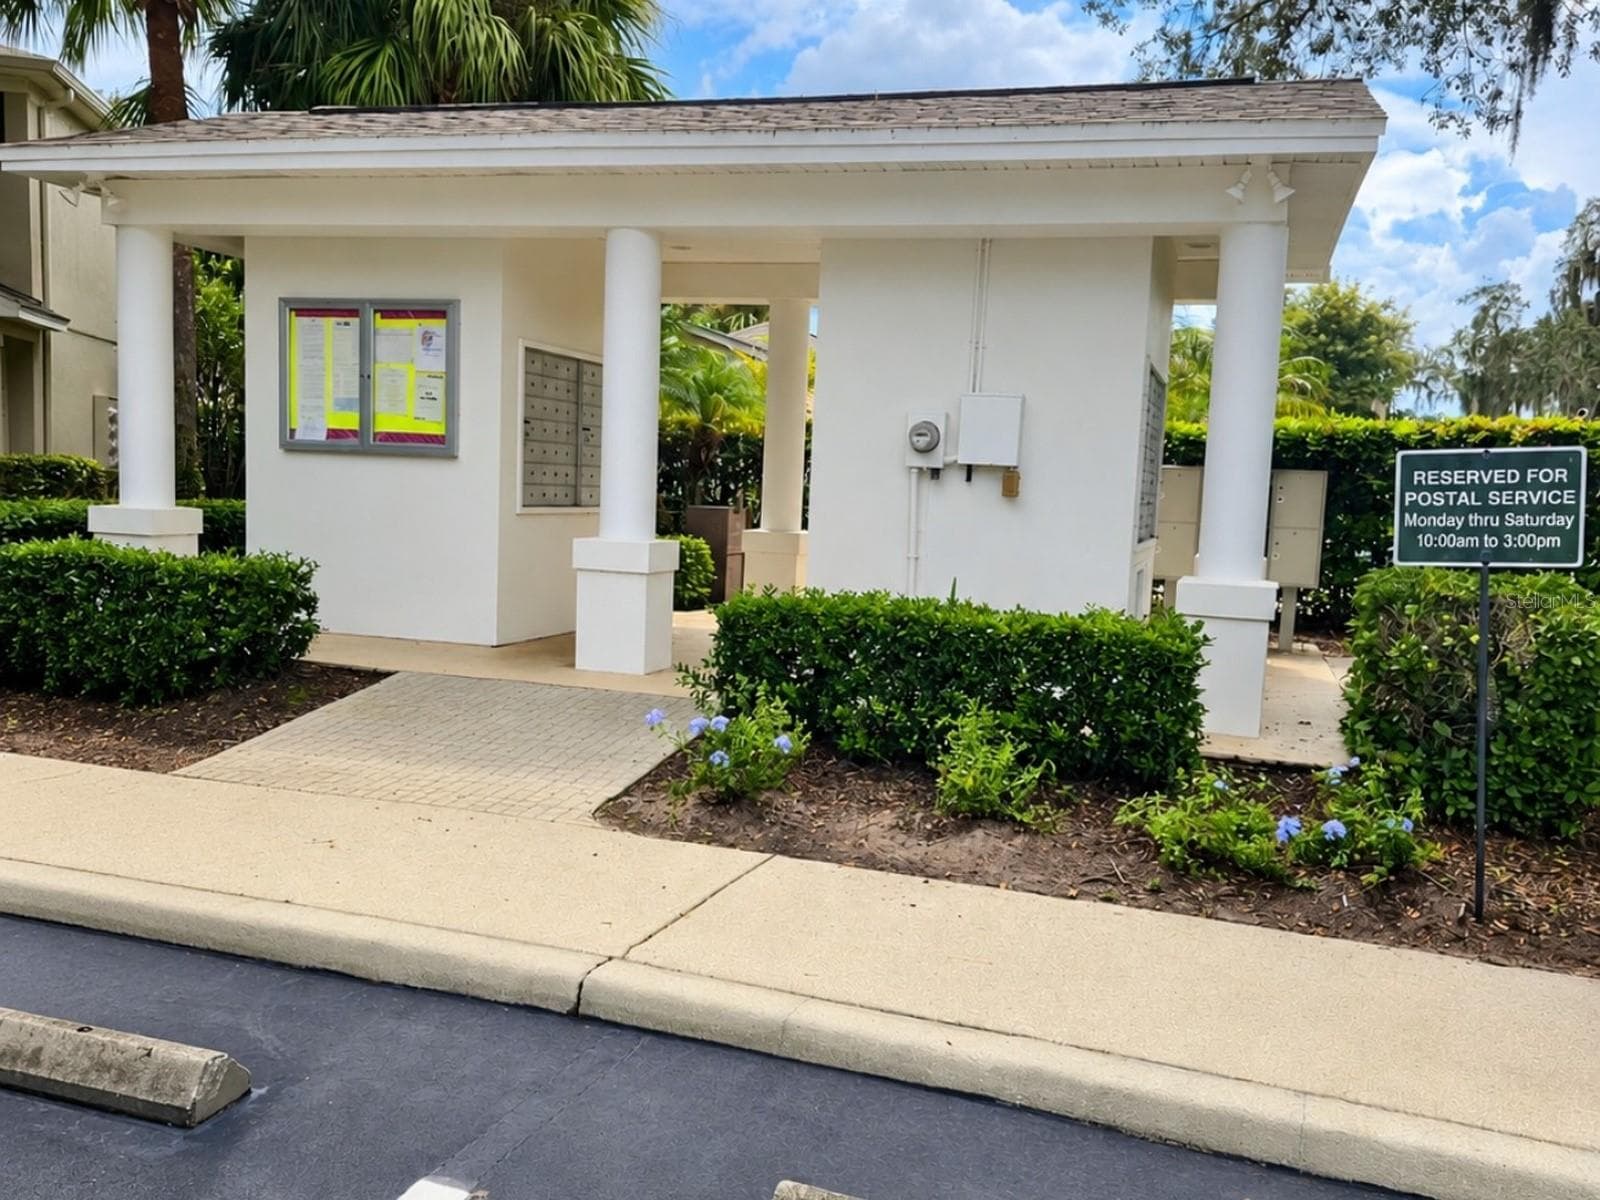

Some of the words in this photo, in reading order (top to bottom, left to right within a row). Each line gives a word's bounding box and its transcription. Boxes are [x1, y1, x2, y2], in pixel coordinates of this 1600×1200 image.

[1413, 470, 1520, 485] RESERVED
[1527, 468, 1568, 483] FOR
[1404, 491, 1482, 506] POSTAL
[1488, 490, 1576, 505] SERVICE
[1404, 513, 1465, 530] Monday
[1468, 513, 1500, 527] thru
[1504, 512, 1575, 530] Saturday
[1417, 533, 1479, 548] 10:00am
[1484, 533, 1499, 548] to
[1503, 533, 1561, 550] 3:00pm
